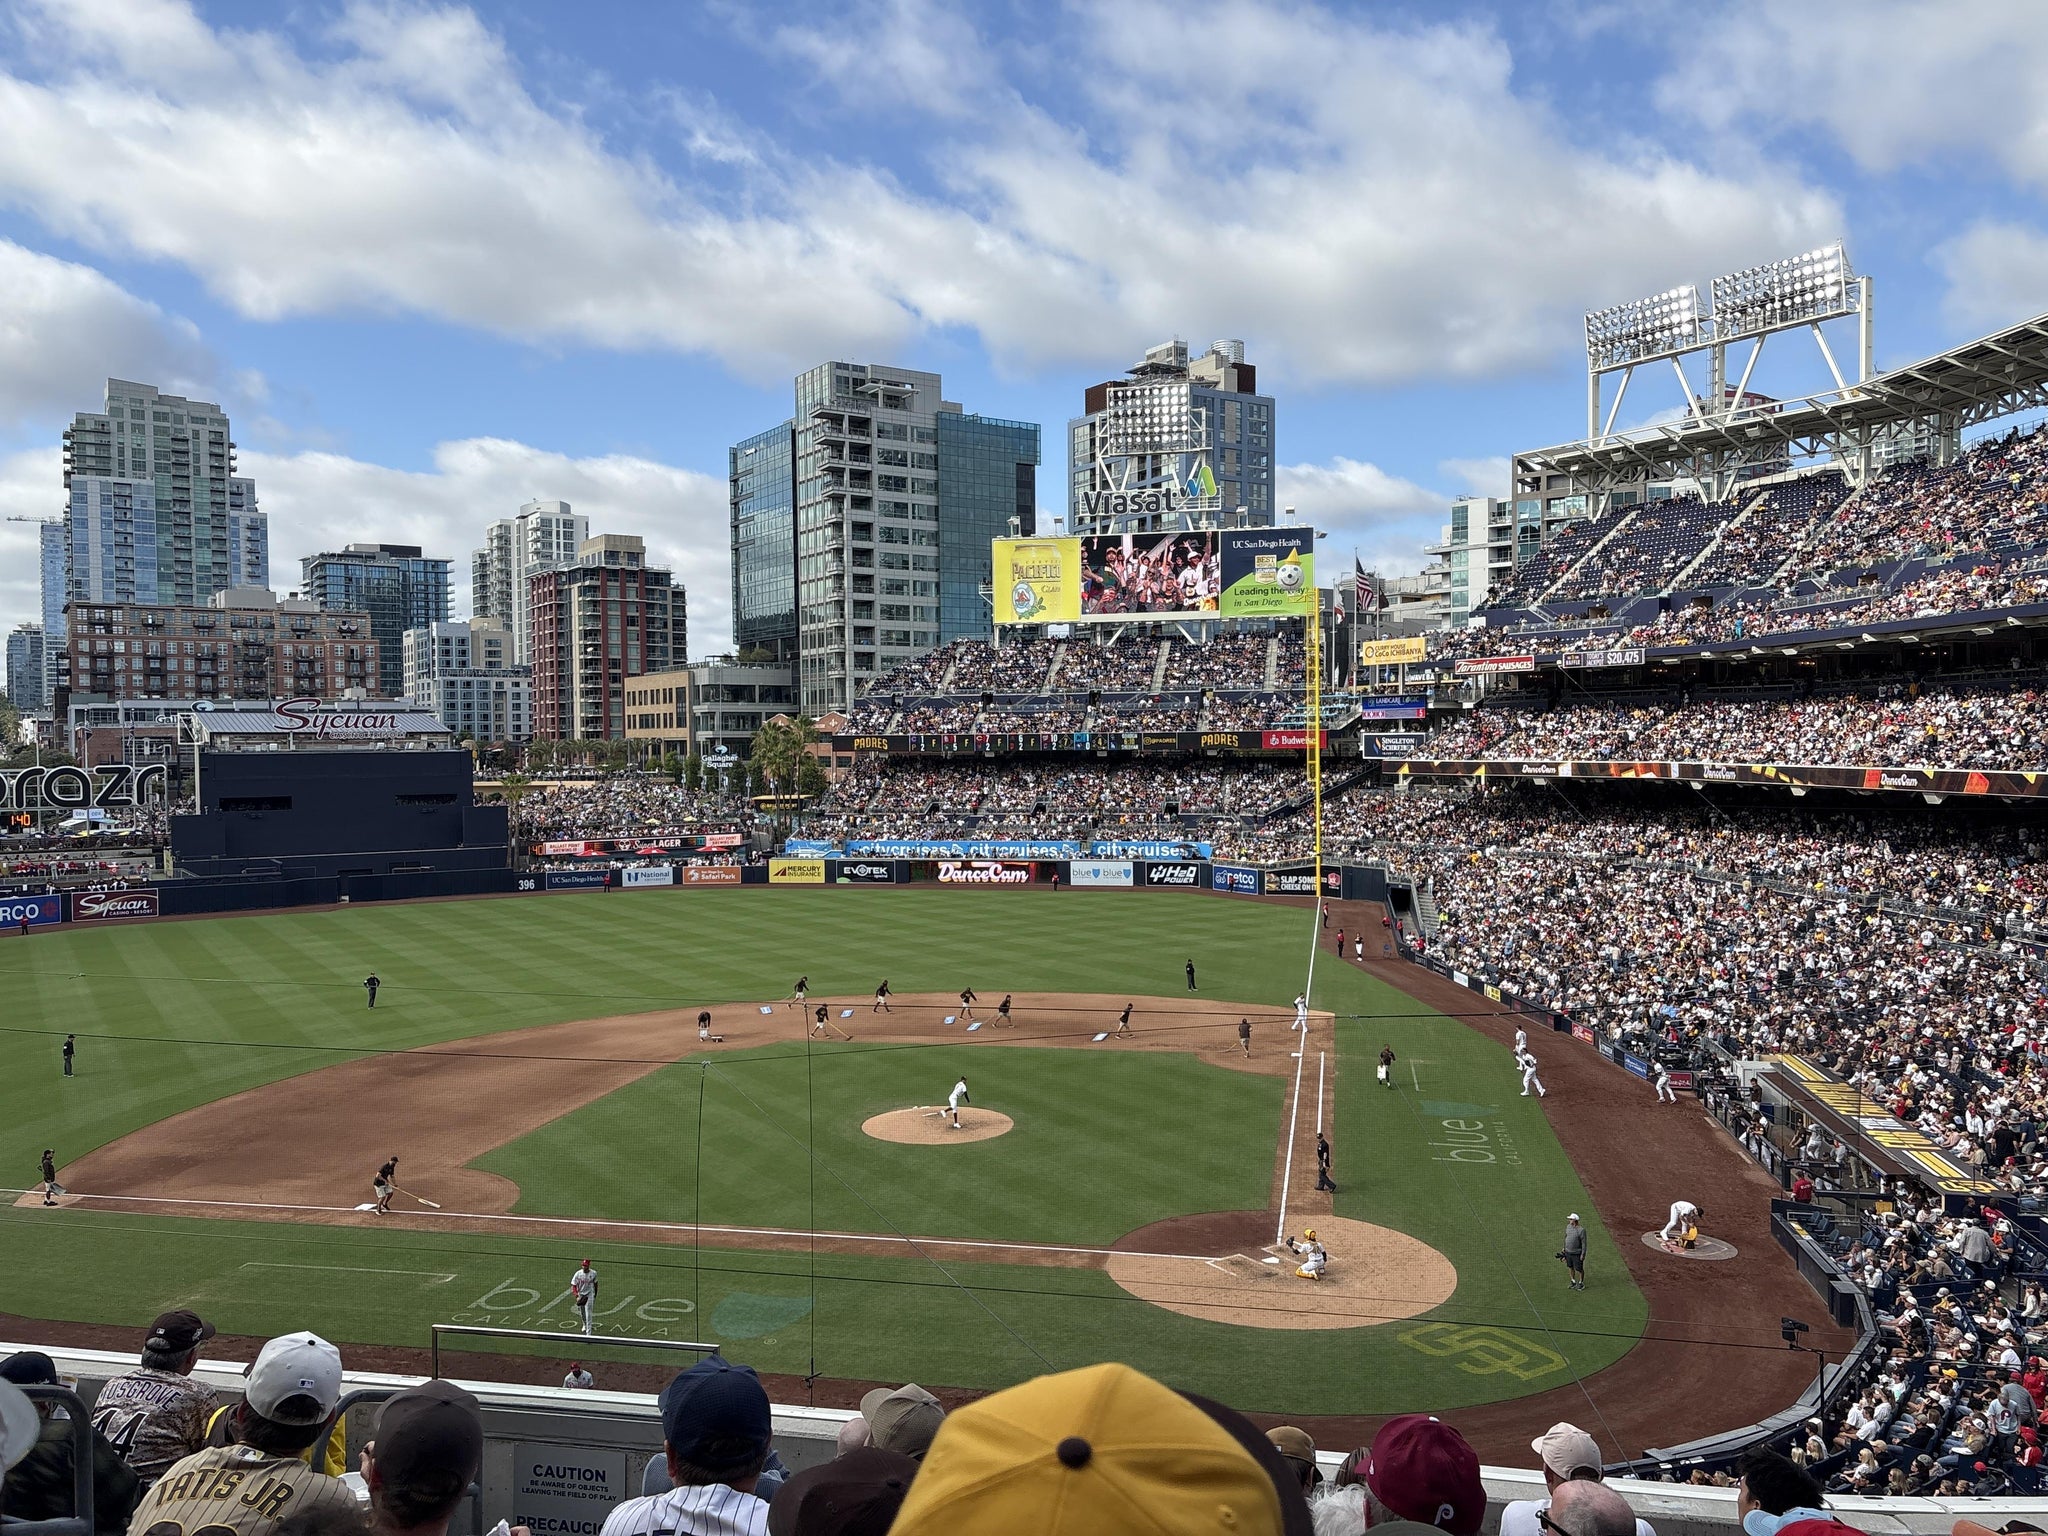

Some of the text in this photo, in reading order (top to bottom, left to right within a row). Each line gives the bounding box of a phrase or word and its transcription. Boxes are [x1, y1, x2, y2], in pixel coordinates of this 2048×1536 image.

[1083, 488, 1177, 515] Viasat
[1232, 538, 1301, 550] UC San Diego Health
[1257, 556, 1275, 564] BEST
[1234, 587, 1270, 598] Leading
[1271, 586, 1284, 596] the
[1244, 598, 1260, 607] San
[1262, 598, 1282, 610] Diego
[1607, 651, 1639, 664] $20,475
[1457, 660, 1532, 672] Tarantino SAUSAGES
[274, 698, 400, 739] Sycuan
[854, 737, 888, 750] PADRES
[932, 739, 936, 747] F
[965, 739, 969, 747] F
[986, 735, 990, 743] 7
[1051, 734, 1058, 742] 10
[1201, 734, 1239, 747] PADRES
[1282, 735, 1317, 745] Budweise
[1522, 764, 1556, 773] DanceCam
[1880, 773, 1918, 786] DanceCam
[11, 814, 30, 825] 1:40
[654, 839, 681, 848] LAGER
[938, 864, 1029, 882] DanceCam
[1072, 868, 1091, 877] blue
[1103, 868, 1122, 877] blue
[1166, 866, 1197, 878] H2O
[518, 878, 535, 890] 396
[572, 876, 586, 884] Diego
[1227, 872, 1254, 885] petco
[80, 894, 150, 917] Sycuan
[1428, 1119, 1498, 1164] blue
[466, 1278, 695, 1322] blue
[451, 1312, 669, 1336] CALIFORNIA
[92, 1408, 150, 1462] 44
[532, 1464, 606, 1486] CAUTION
[522, 1487, 551, 1495] LEAVING
[541, 1480, 565, 1489] AWARE
[578, 1484, 609, 1493] OBJECTS
[156, 1468, 294, 1523] TATIS JR.
[1434, 1503, 1454, 1526] P
